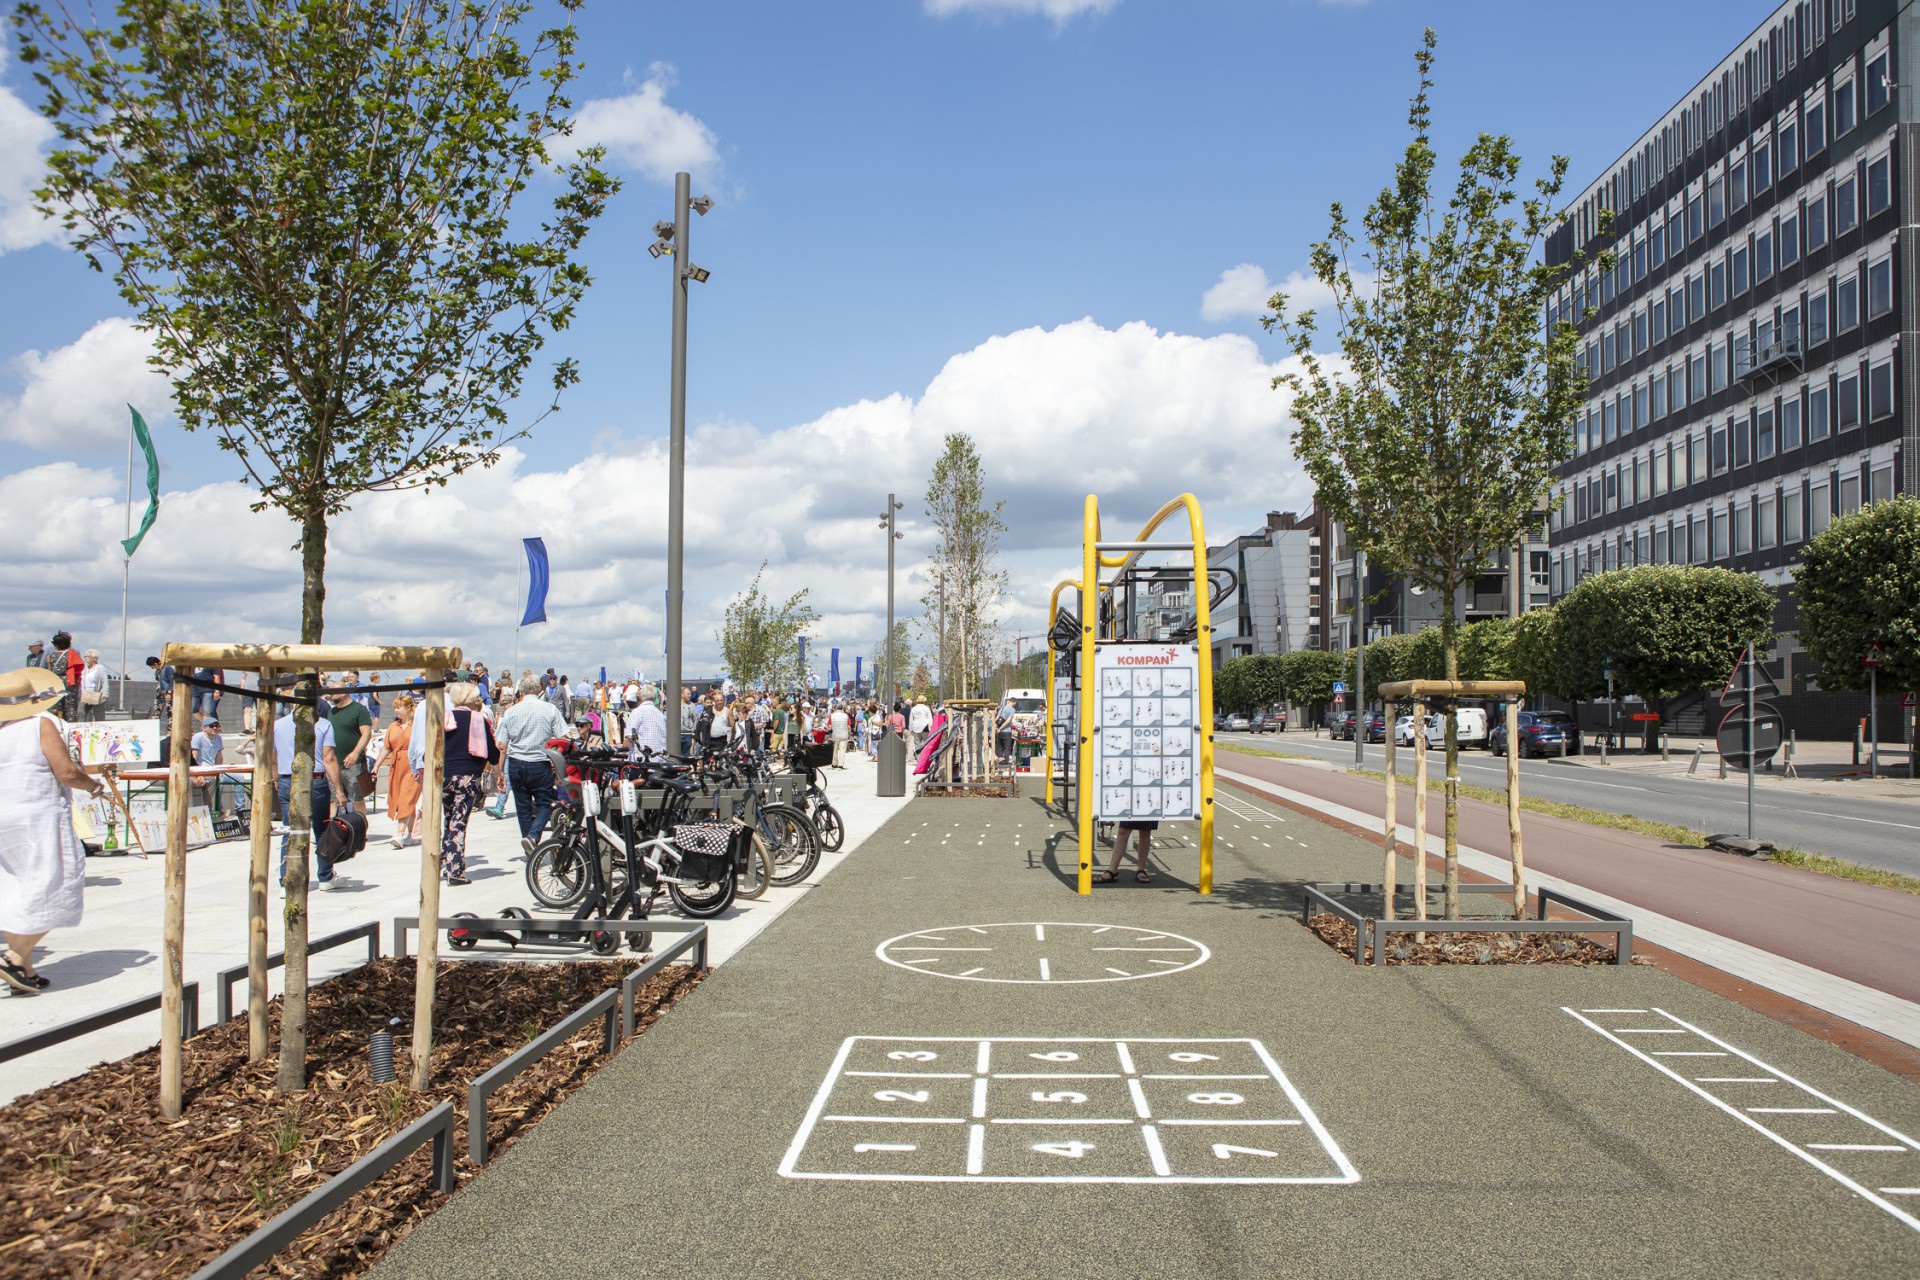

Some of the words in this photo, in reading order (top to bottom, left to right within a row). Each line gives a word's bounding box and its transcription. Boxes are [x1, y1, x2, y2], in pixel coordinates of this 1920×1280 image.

[1117, 656, 1169, 665] KOMPAN
[886, 1050, 939, 1062] 3
[1028, 1050, 1080, 1062] 6
[1168, 1051, 1221, 1063] 9
[872, 1089, 930, 1103] 2
[1030, 1090, 1090, 1104] 5
[1186, 1091, 1245, 1106] 8
[853, 1141, 918, 1153] 1
[1028, 1139, 1097, 1159] 4
[1211, 1143, 1279, 1160] 7
